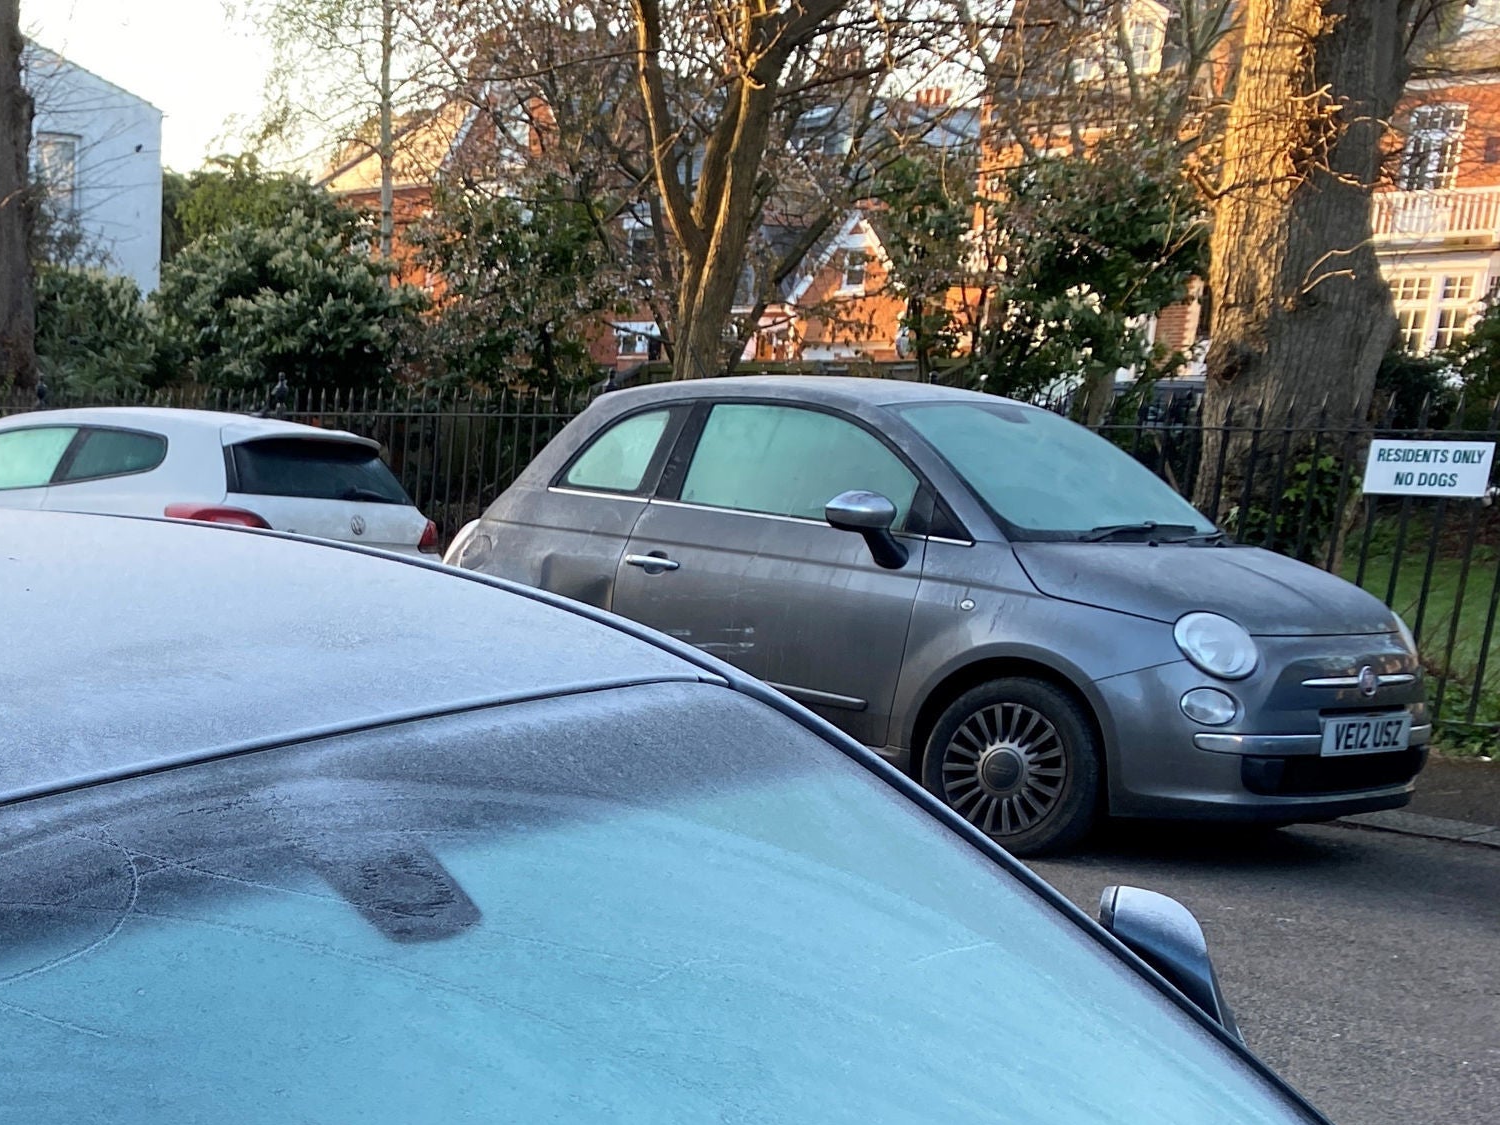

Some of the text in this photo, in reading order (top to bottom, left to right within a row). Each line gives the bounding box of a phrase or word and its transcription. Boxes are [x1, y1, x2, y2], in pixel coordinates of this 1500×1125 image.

[1377, 448, 1486, 464] RESIDENTS ONLY
[1394, 471, 1458, 487] NO DOGS
[1335, 720, 1403, 750] VE12 USZ
